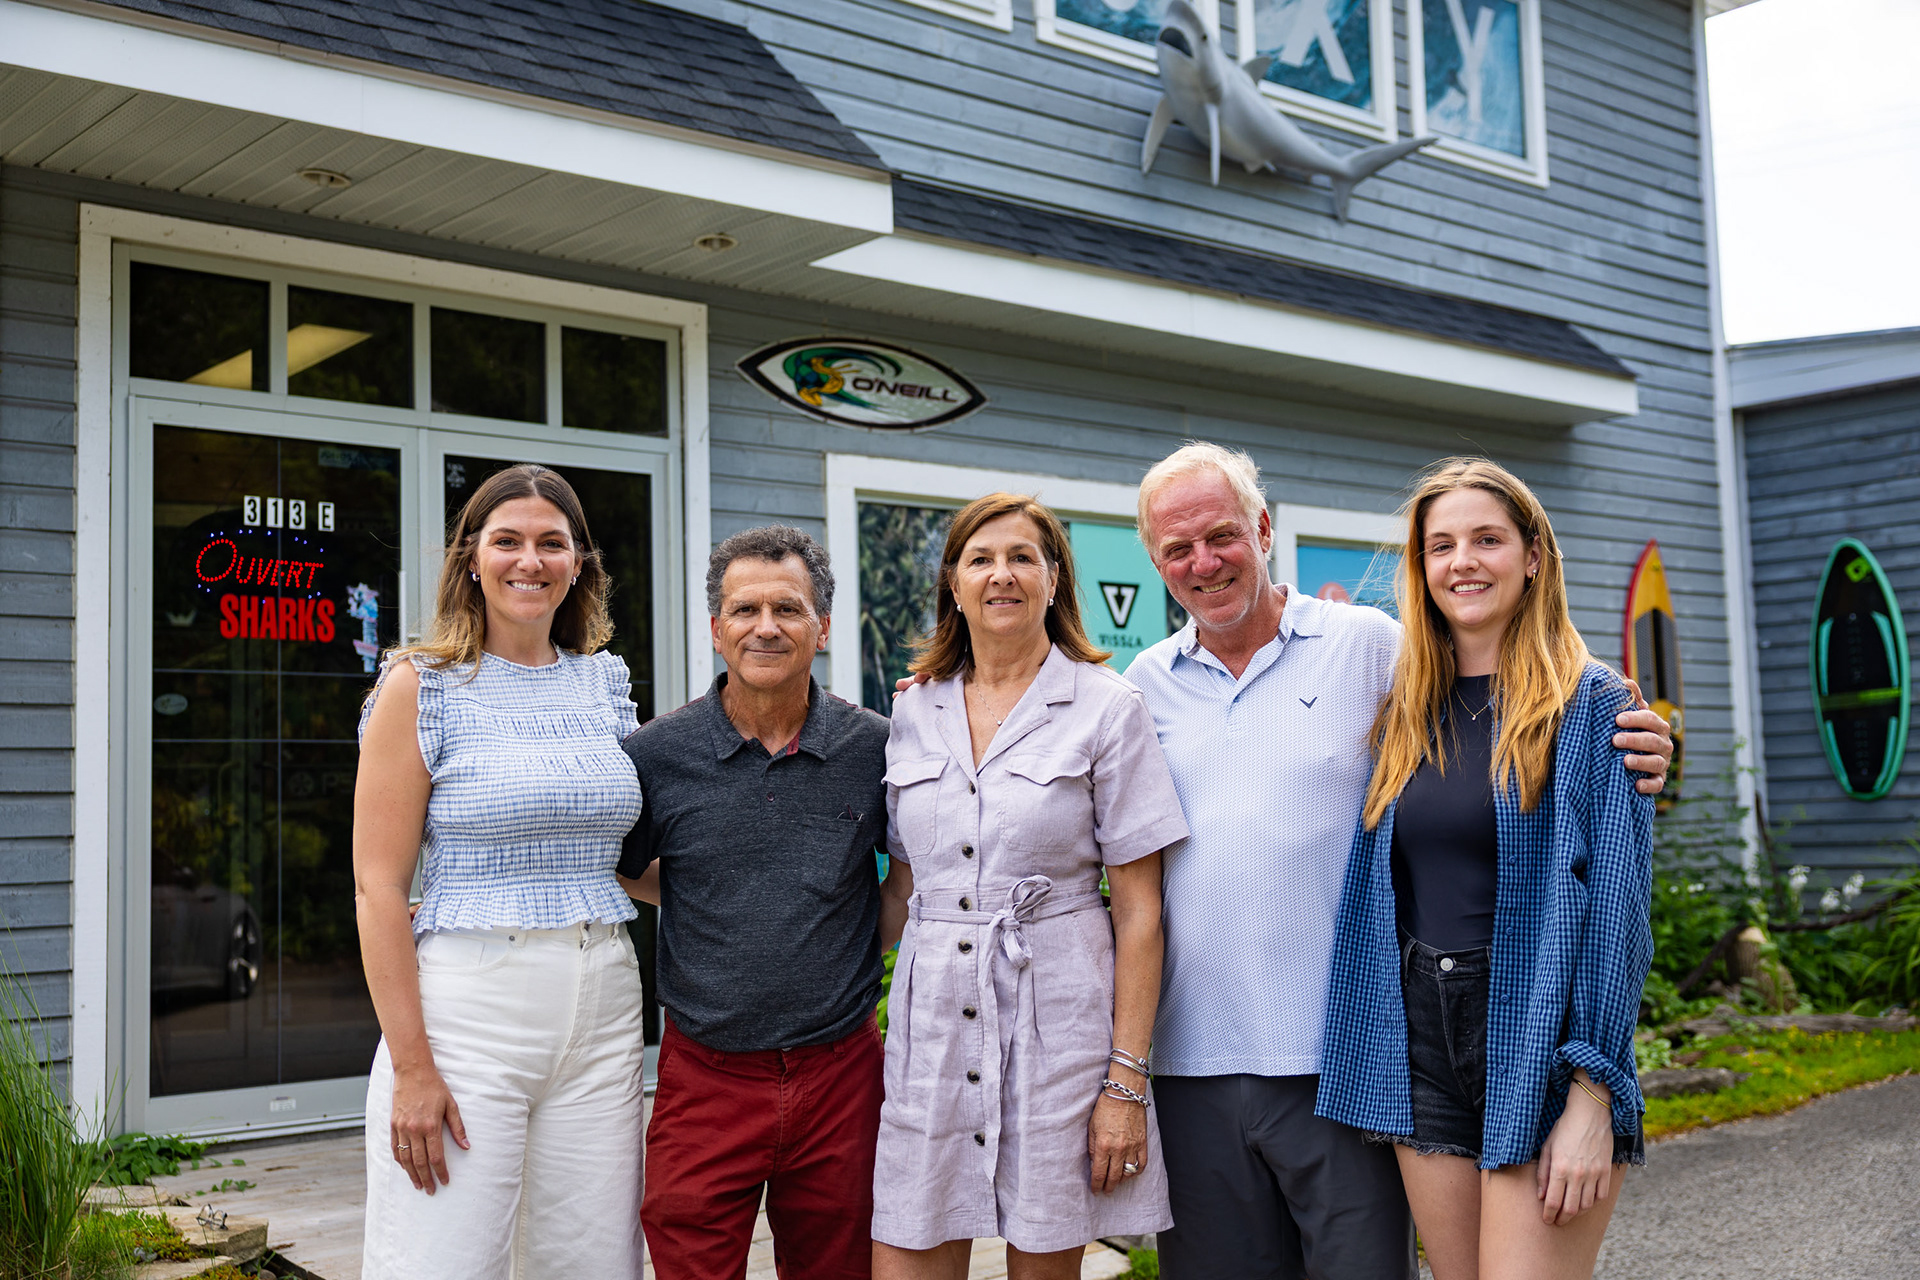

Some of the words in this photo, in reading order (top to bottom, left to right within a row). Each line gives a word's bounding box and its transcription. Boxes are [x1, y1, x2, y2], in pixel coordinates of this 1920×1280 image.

[852, 377, 957, 403] O'NEILL
[196, 538, 324, 588] OUVERT
[220, 593, 336, 643] SHARKS
